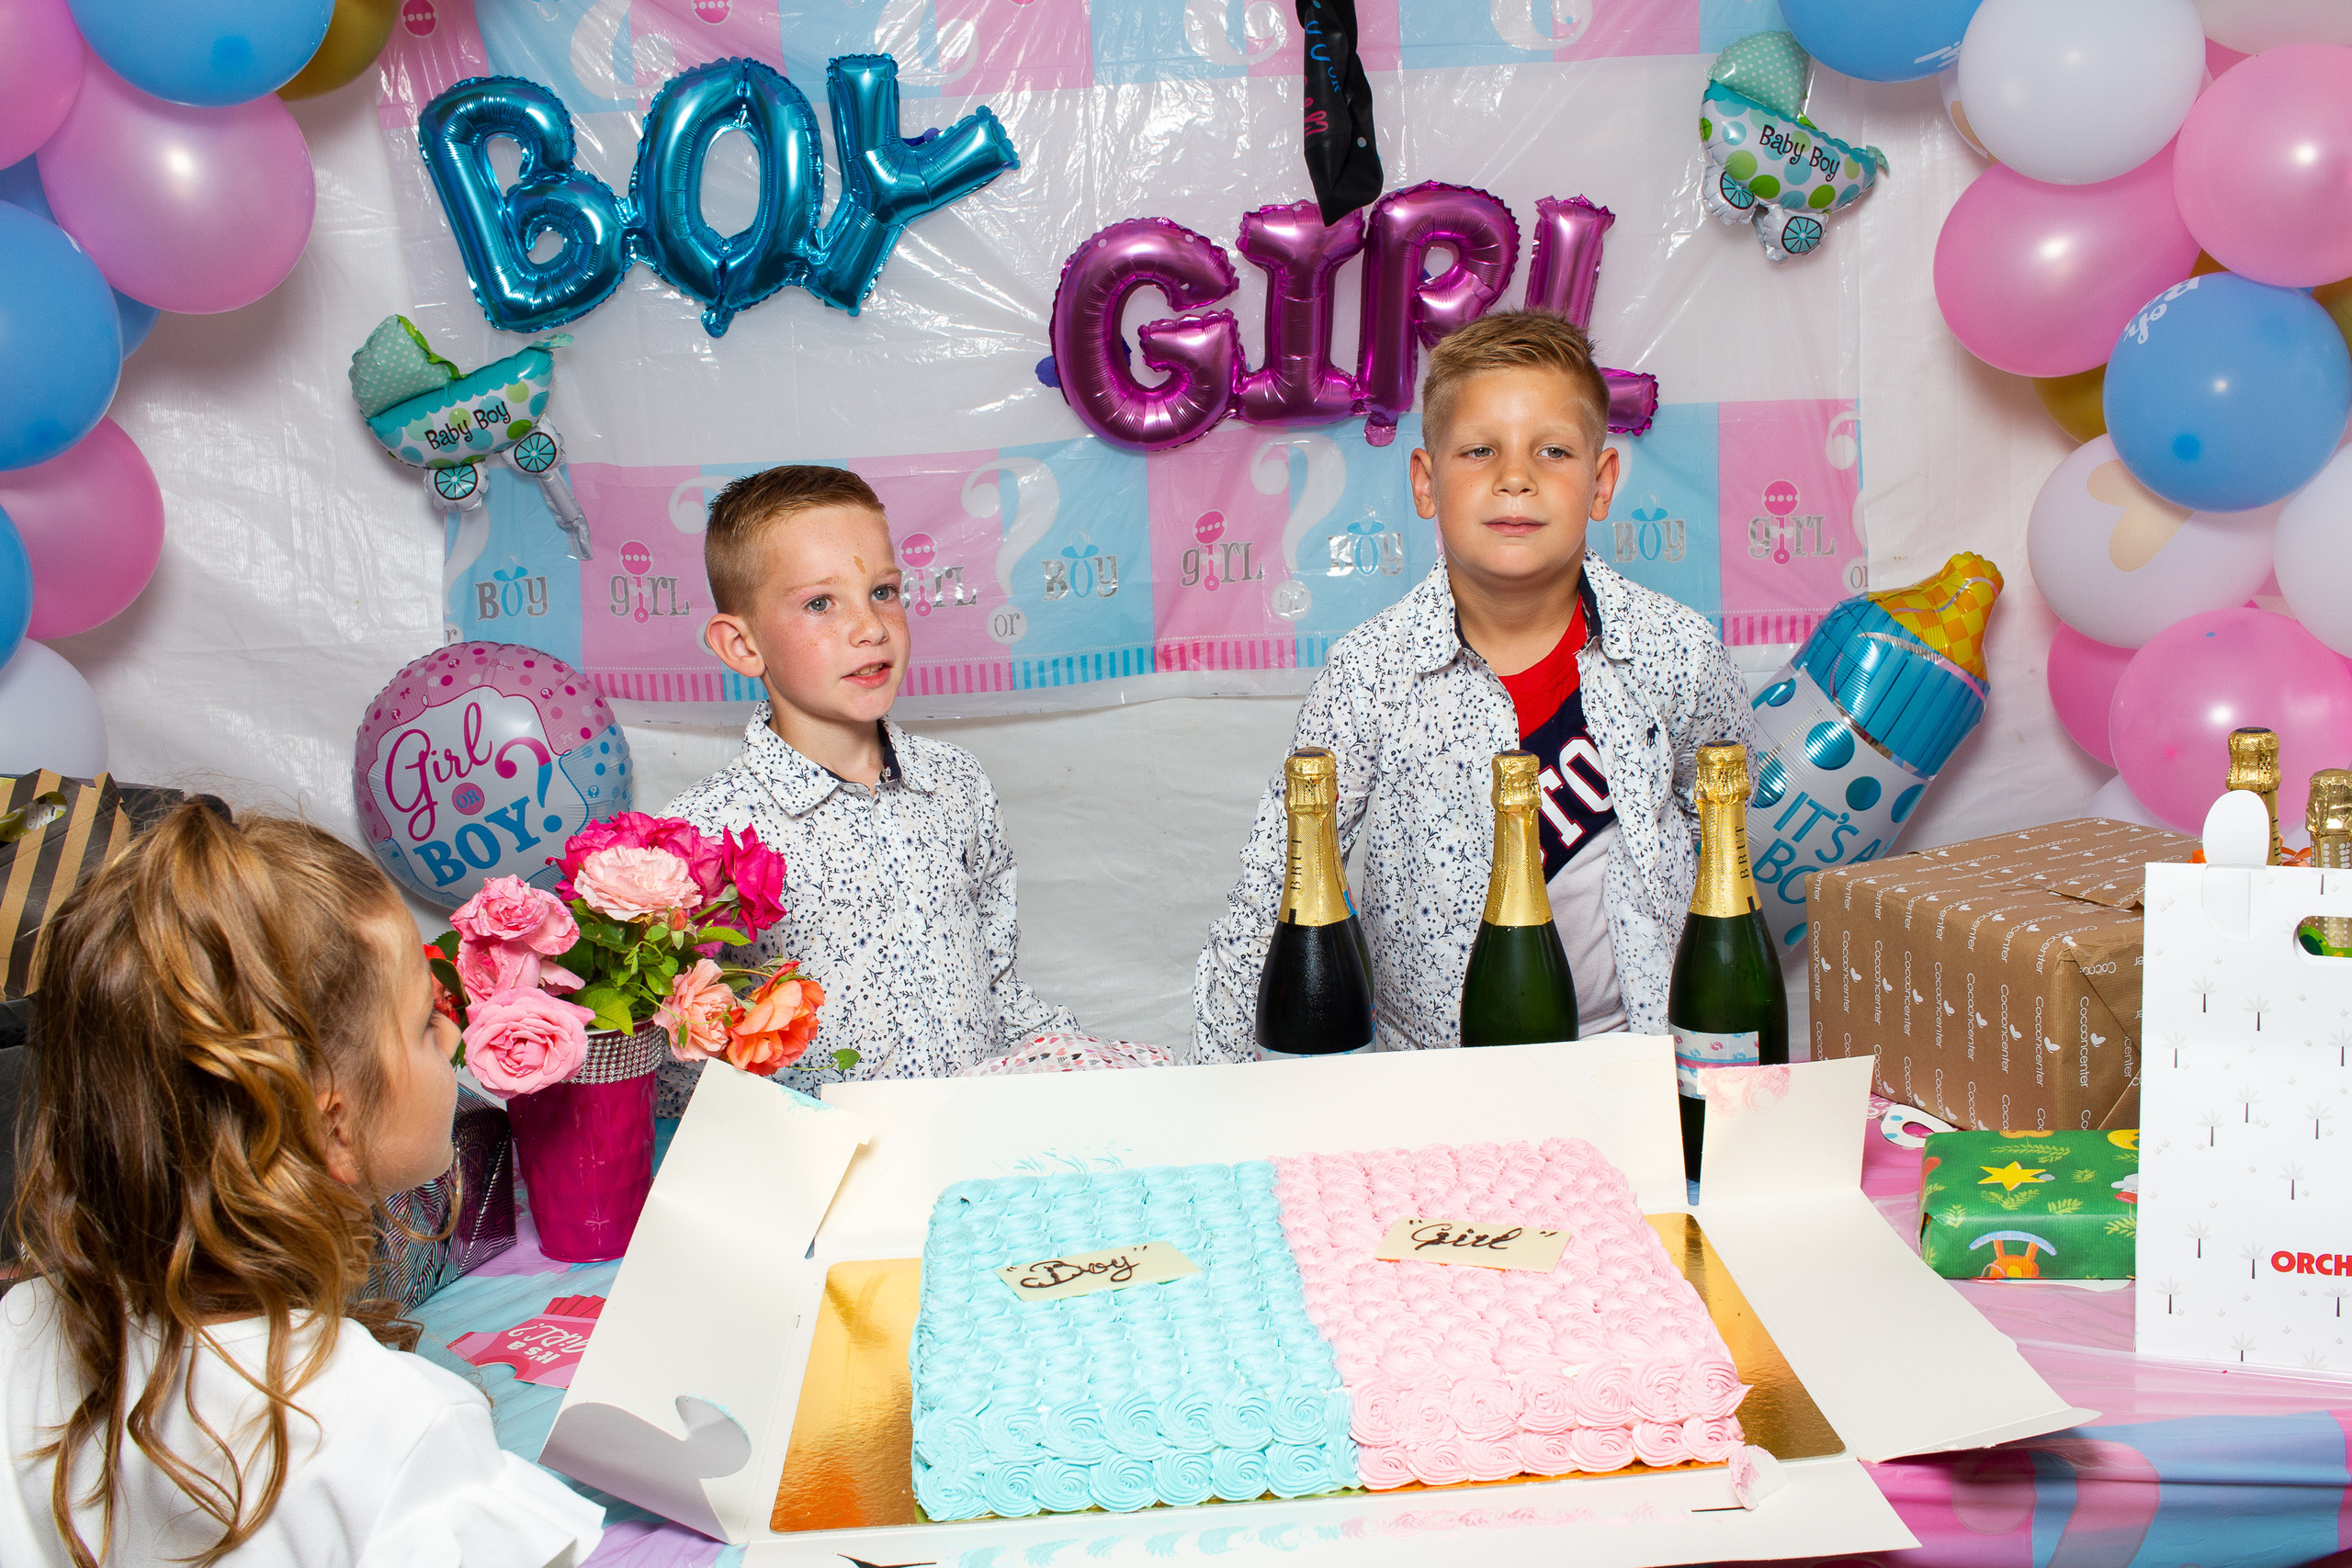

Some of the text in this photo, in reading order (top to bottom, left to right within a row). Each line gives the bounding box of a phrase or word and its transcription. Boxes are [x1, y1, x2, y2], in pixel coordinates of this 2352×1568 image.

[1759, 124, 1840, 182] Baby Boy
[418, 55, 1020, 337] BOY
[424, 400, 511, 450] Baby Boy
[994, 613, 1021, 637] or
[384, 702, 492, 841] Girl
[457, 789, 481, 808] OR
[1538, 726, 1614, 863] TO
[1290, 835, 1302, 890] BRUT
[1735, 826, 1750, 879] BRUT
[1773, 791, 1860, 863] IT'S
[1752, 838, 1822, 904] BO
[1813, 920, 1822, 1003] Cocooncenter
[1842, 931, 1851, 1014] Cocooncenter
[1874, 940, 1883, 1025] Cocooncenter
[1904, 951, 1912, 1037] Cocooncenter
[1934, 961, 1944, 1049] Cocooncenter
[1966, 972, 1976, 1062] Cocooncenter
[2000, 984, 2010, 1074] Cocooncenter
[2035, 996, 2045, 1088] Cocooncenter
[2079, 996, 2090, 1088] Cocooncenter
[2271, 1250, 2352, 1277] ORCH
